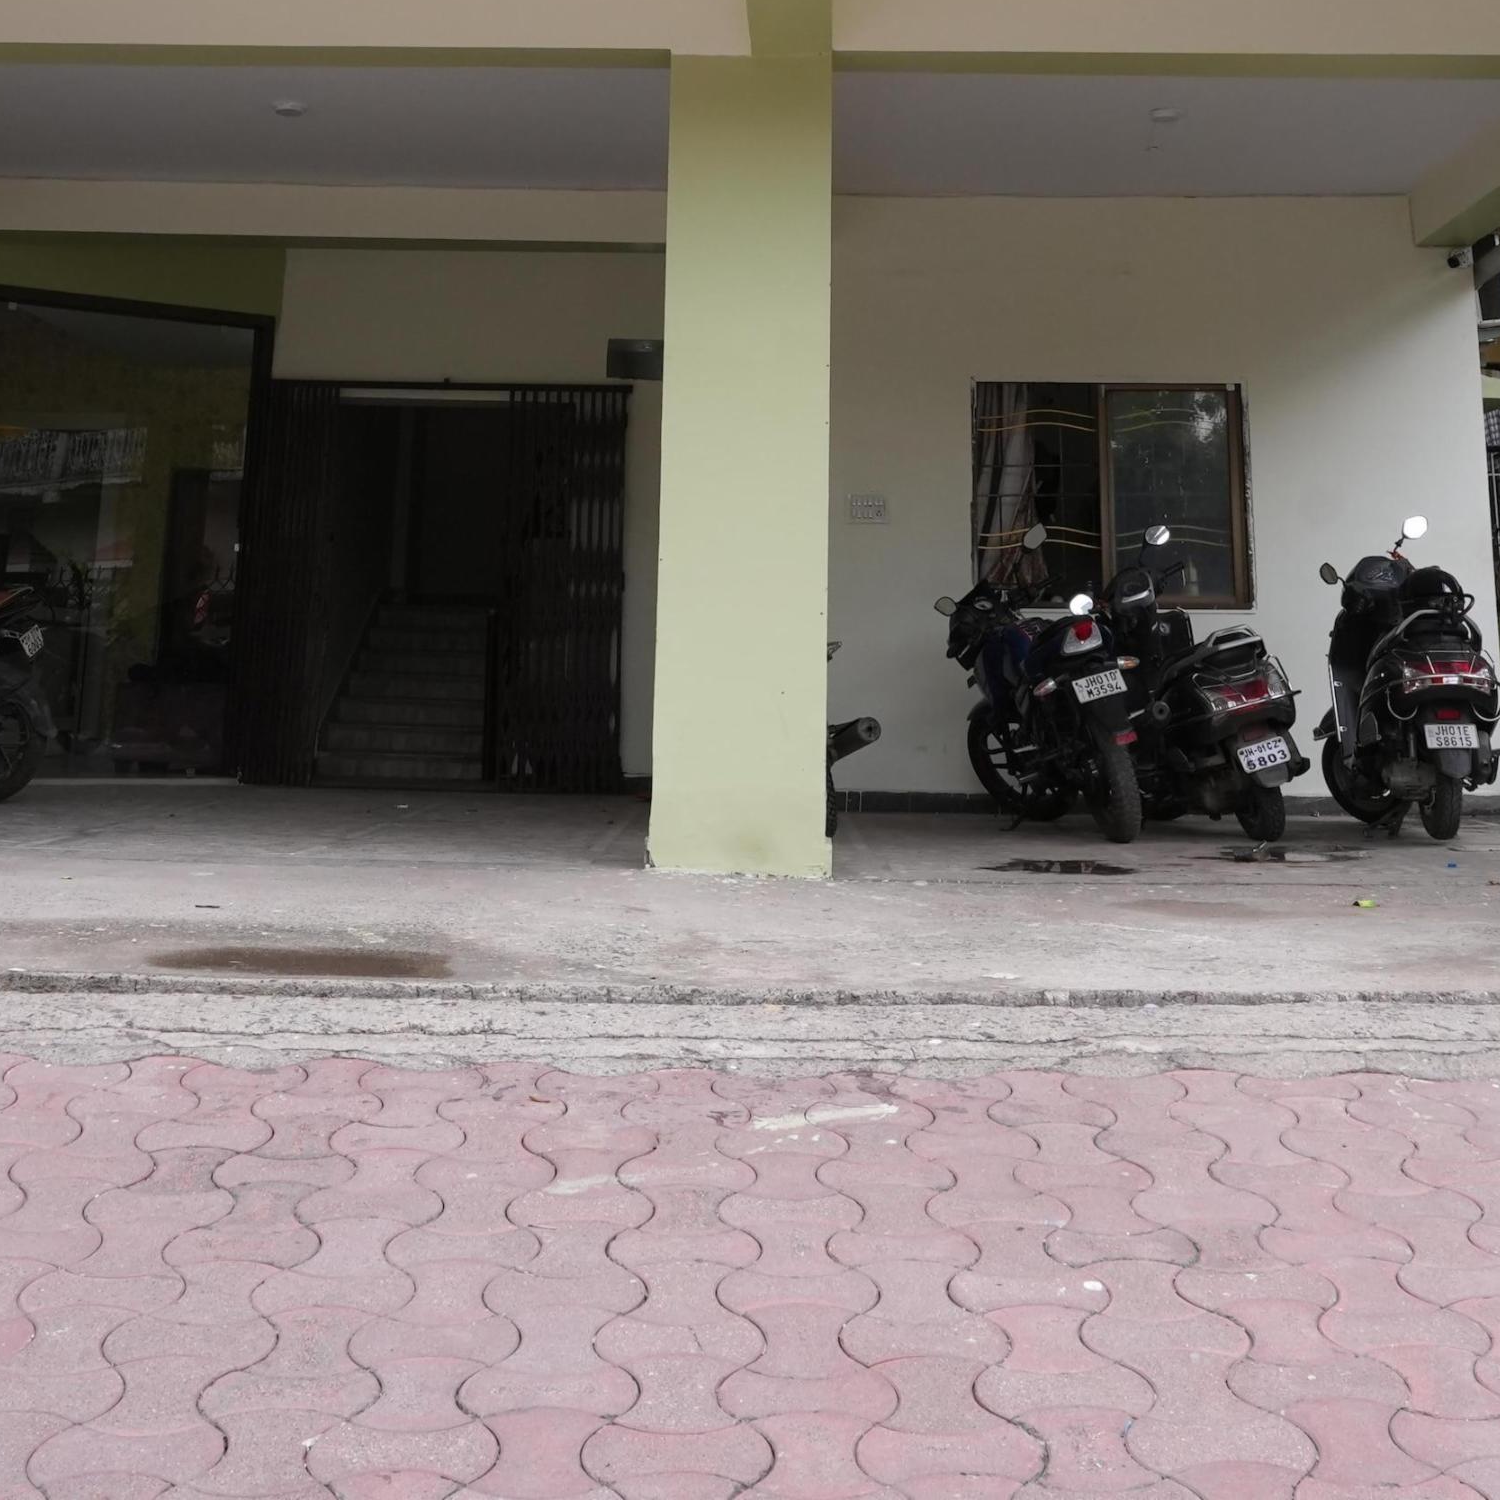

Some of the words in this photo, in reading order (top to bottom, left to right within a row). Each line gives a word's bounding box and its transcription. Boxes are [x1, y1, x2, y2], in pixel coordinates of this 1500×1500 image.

[1087, 682, 1122, 698] M3594
[1435, 725, 1470, 736] JH01E
[1436, 736, 1473, 747] S8615
[1246, 749, 1288, 770] 5803
